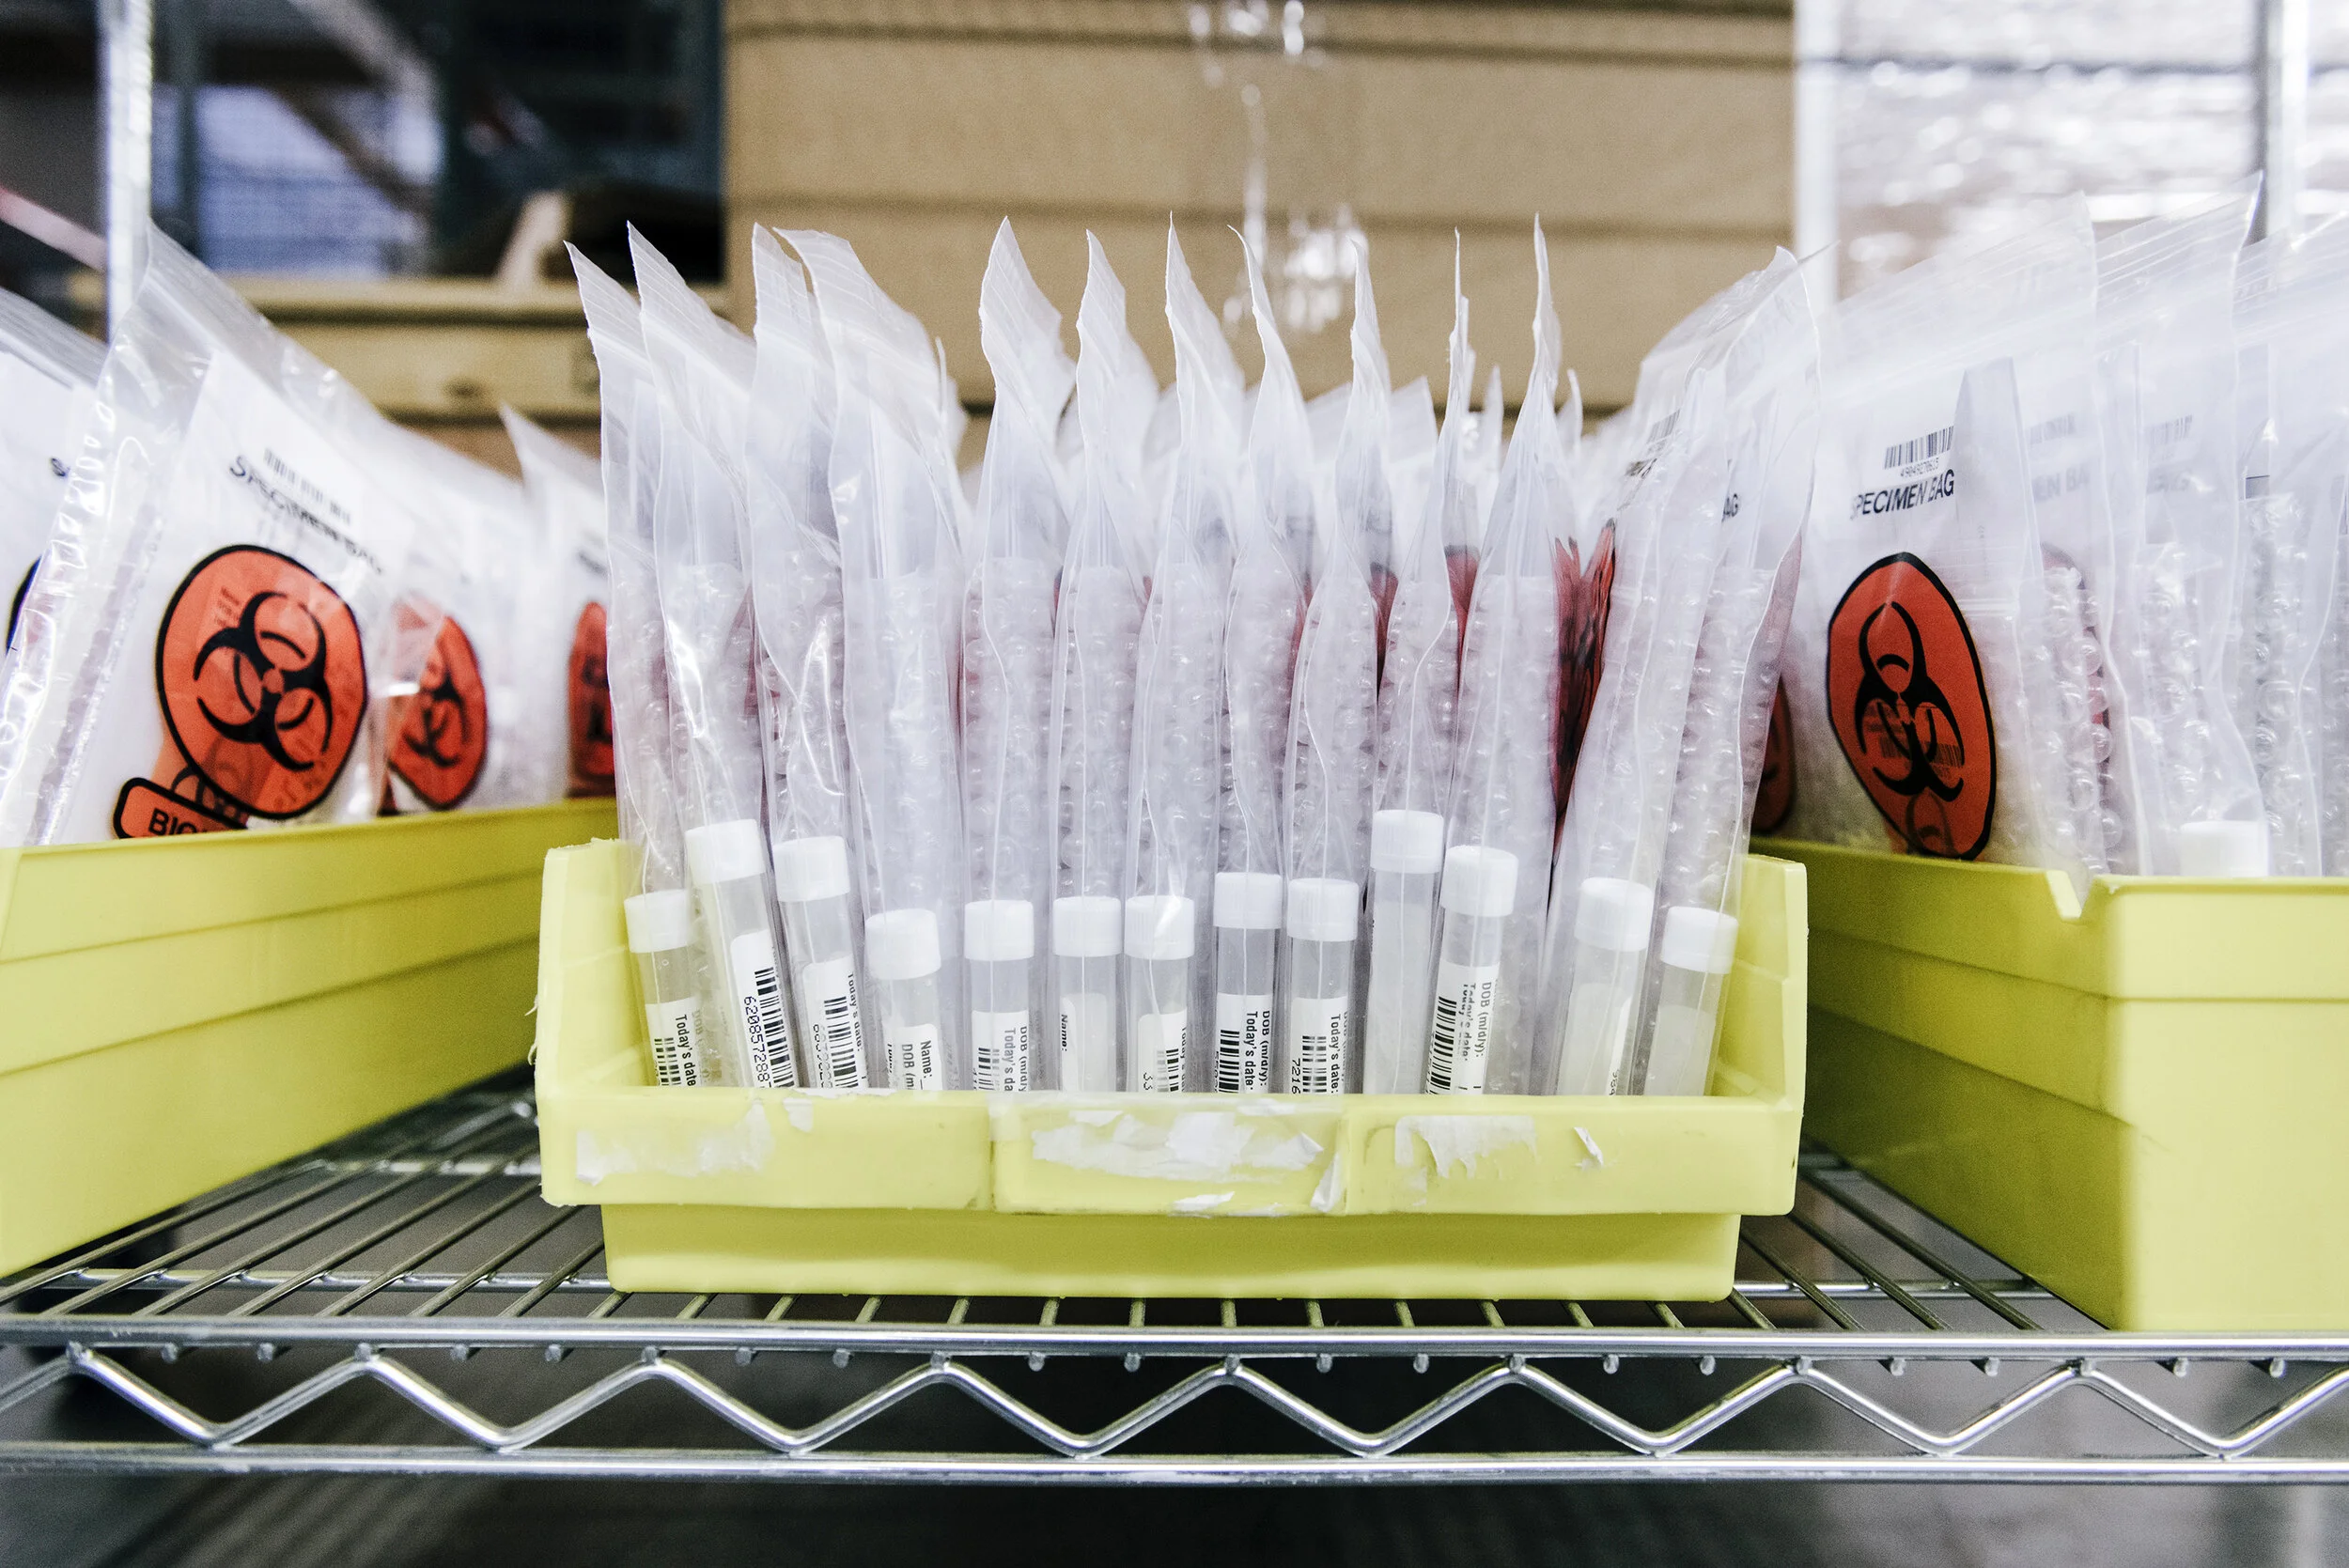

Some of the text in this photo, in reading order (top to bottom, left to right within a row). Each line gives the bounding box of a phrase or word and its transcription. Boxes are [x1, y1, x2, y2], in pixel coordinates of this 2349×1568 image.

[1927, 469, 1955, 504] BAG
[676, 1014, 692, 1060] Today's
[1019, 1026, 1028, 1052] DOB
[1243, 1011, 1258, 1057] Today's
[1474, 982, 1492, 1058] DOB (m/d/y):
[920, 1039, 933, 1079] Name:
[1002, 1028, 1017, 1074] Today's
[1259, 1010, 1270, 1087] DOB (m/d/y):
[1329, 1014, 1341, 1094] Today's date:
[905, 1073, 917, 1090] (m
[1292, 1058, 1301, 1094] 7216
